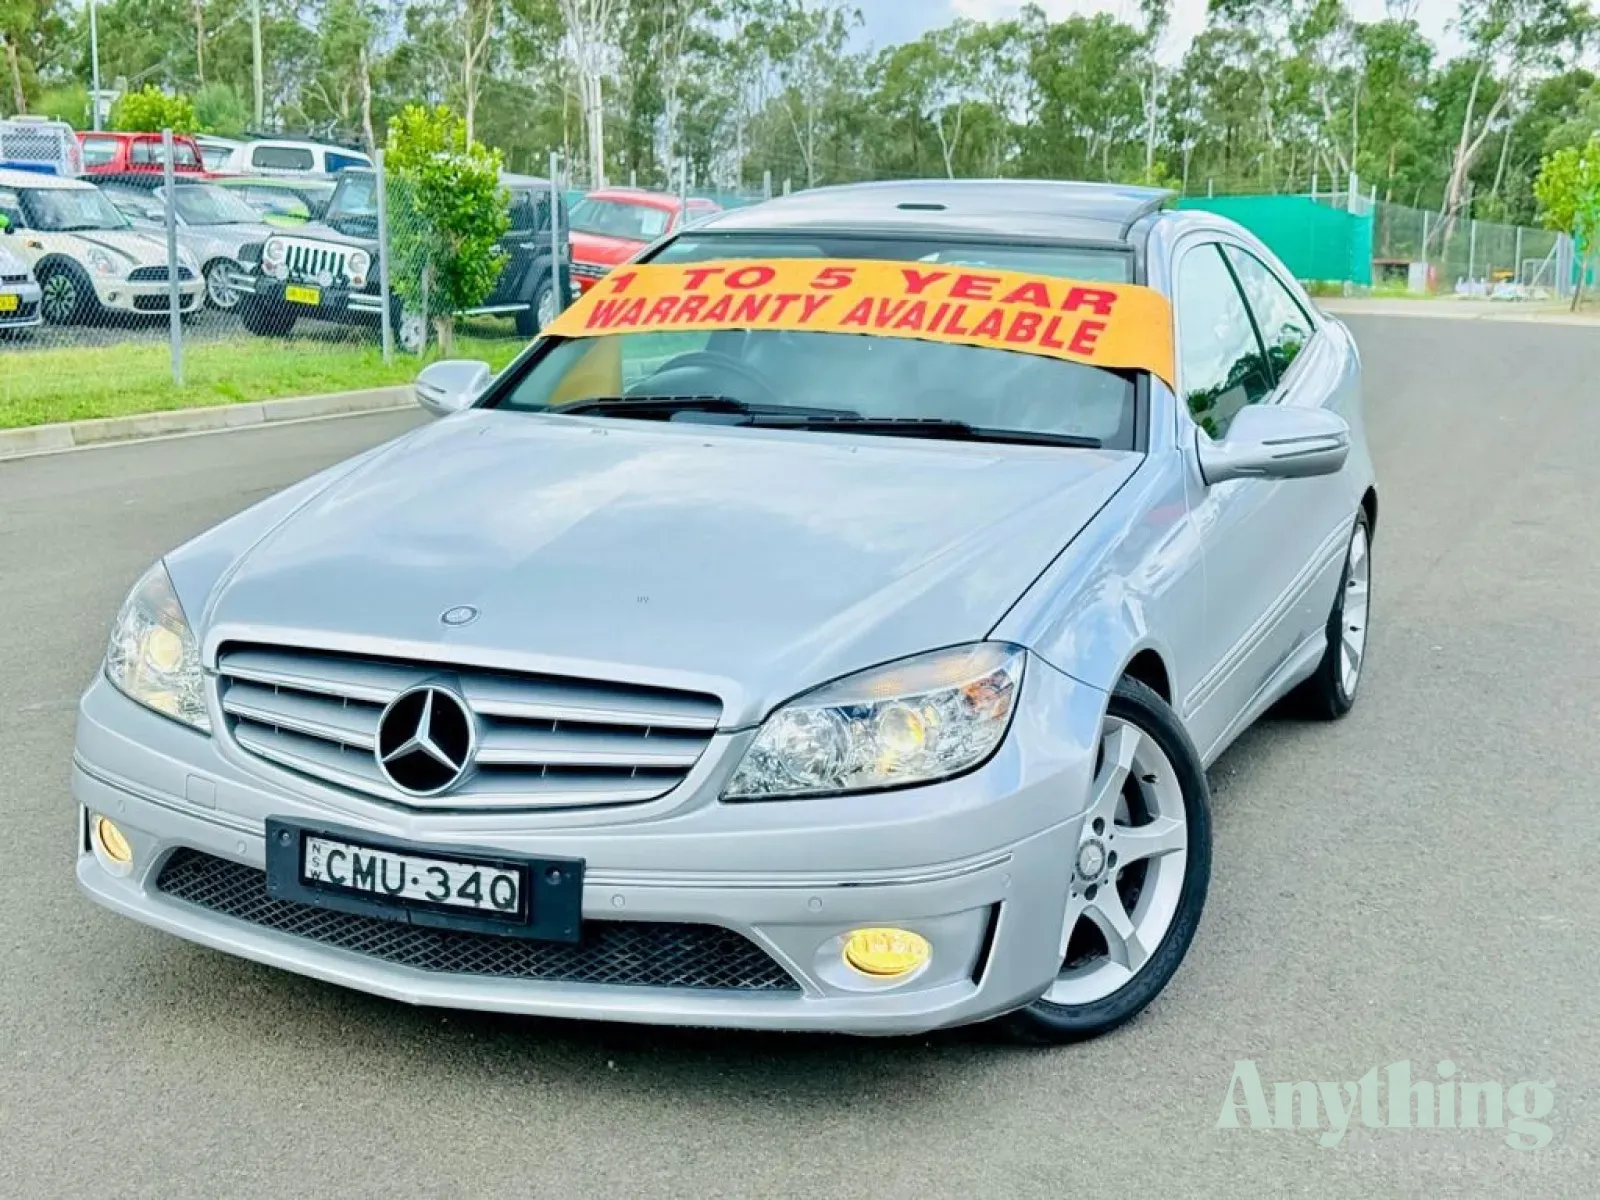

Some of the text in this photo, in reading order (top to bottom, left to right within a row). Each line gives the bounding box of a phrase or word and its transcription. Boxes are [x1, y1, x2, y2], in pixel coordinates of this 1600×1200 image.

[609, 266, 1119, 315] 1 TO 5 YEAR
[585, 294, 1107, 356] WARRANTY AVAILABLE
